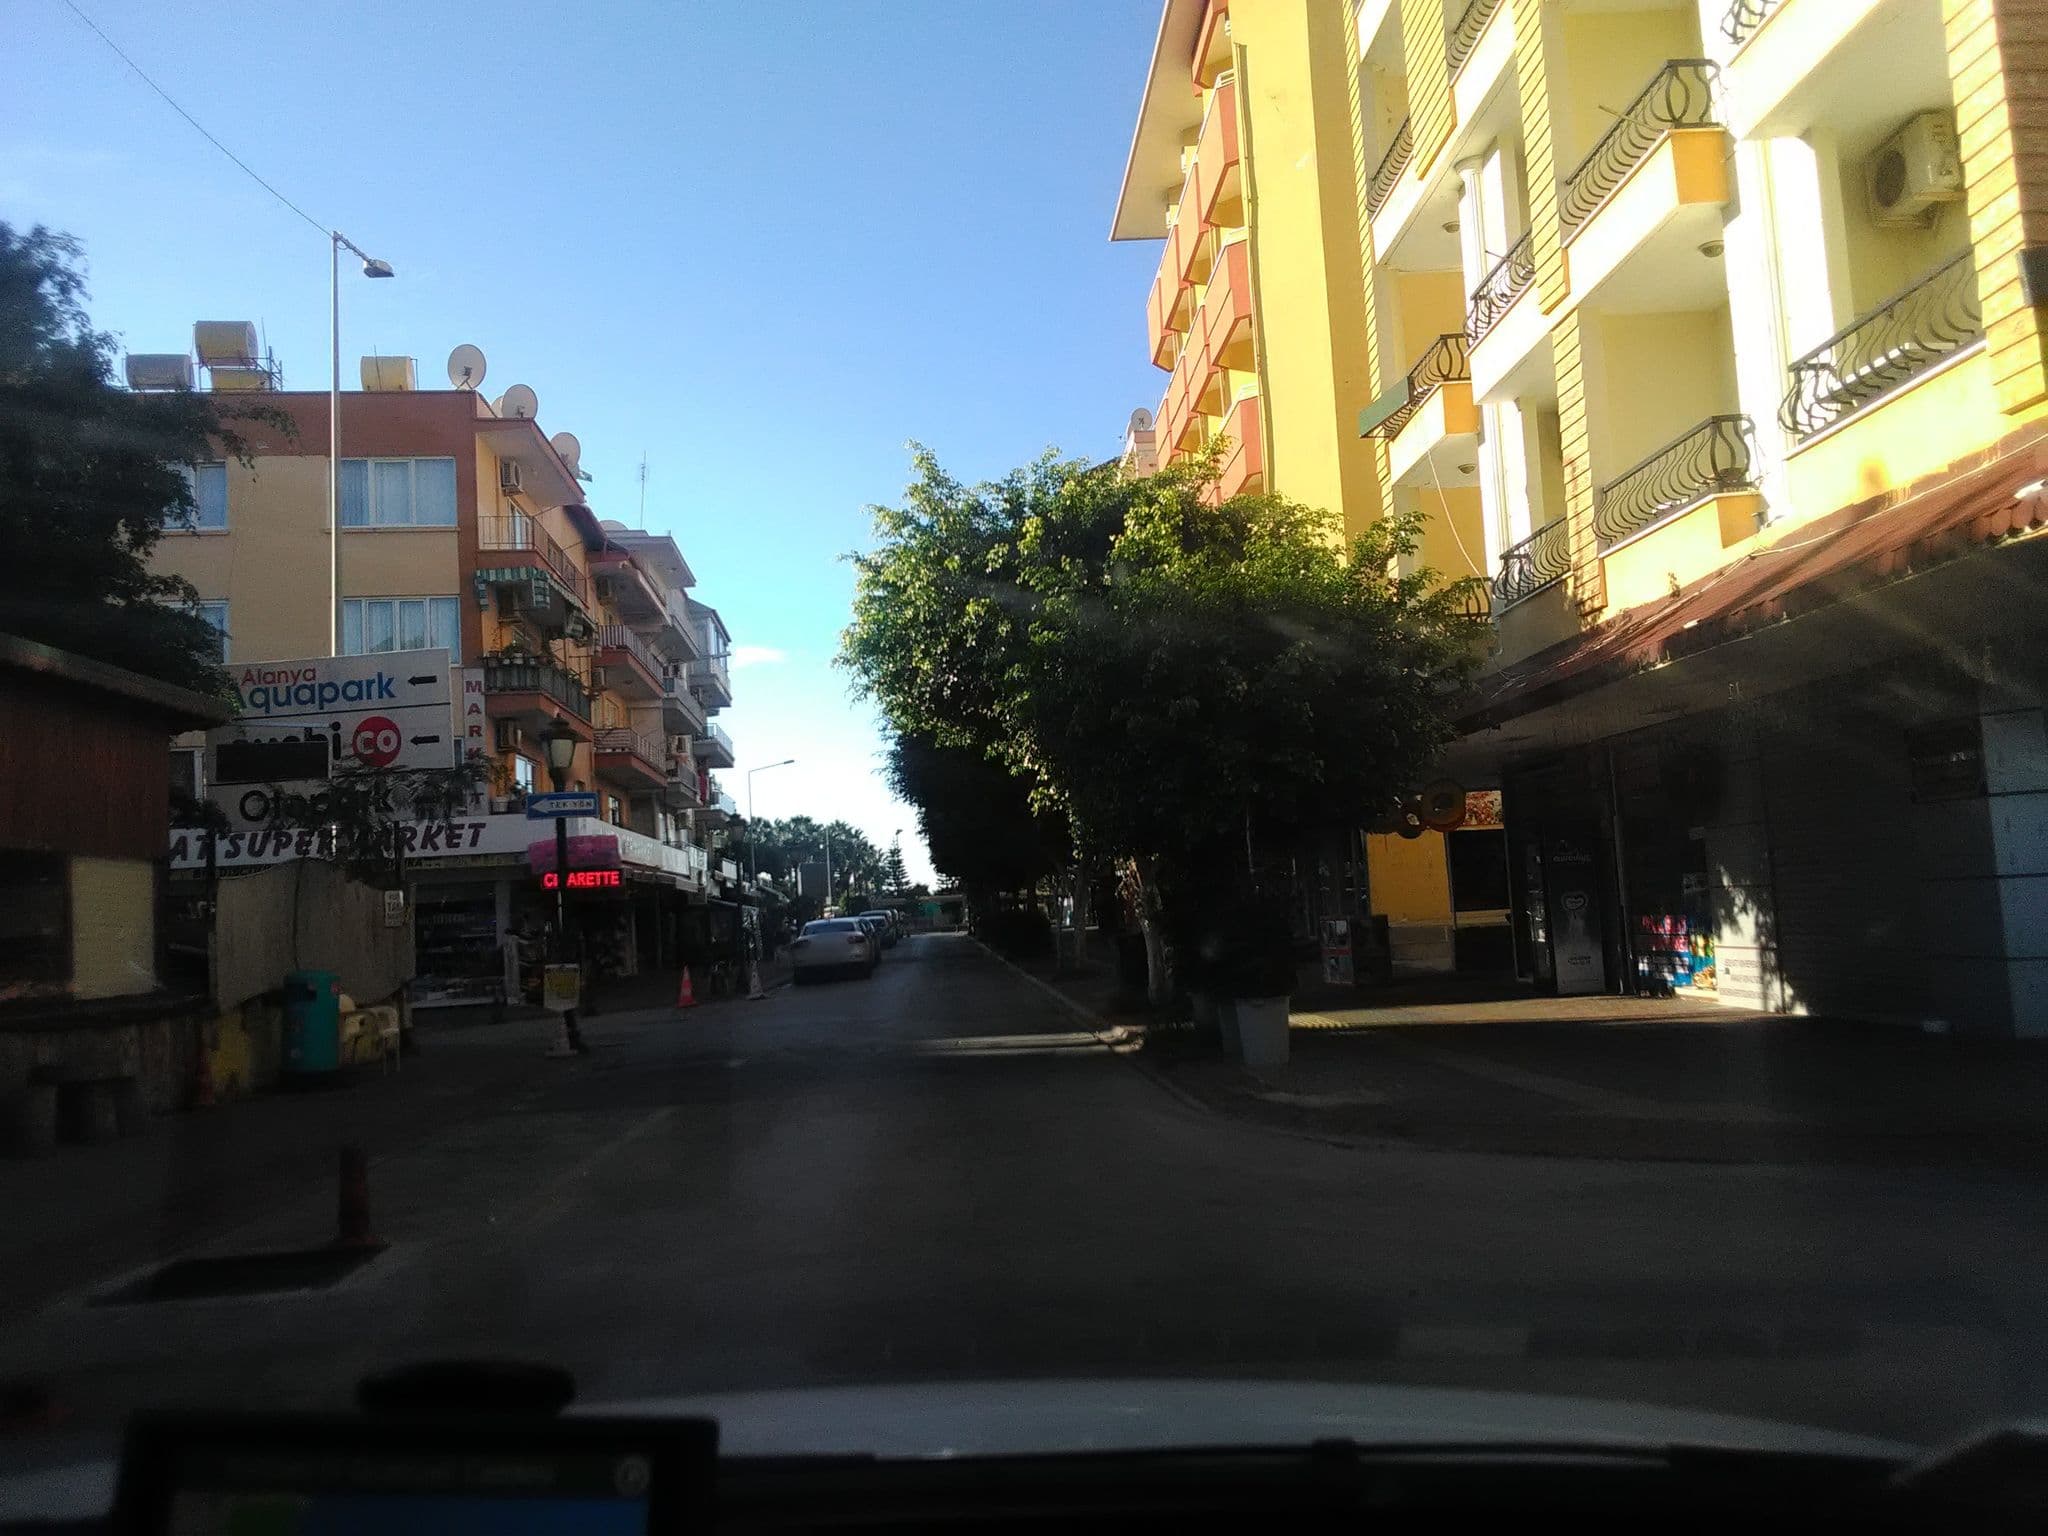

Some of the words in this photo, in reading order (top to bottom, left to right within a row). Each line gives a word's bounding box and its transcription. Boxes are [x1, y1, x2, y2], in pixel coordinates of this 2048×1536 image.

[240, 667, 317, 687] Alanya
[465, 680, 485, 804] MARKT
[551, 800, 568, 808] TEK
[542, 870, 622, 890] CIARETTE
